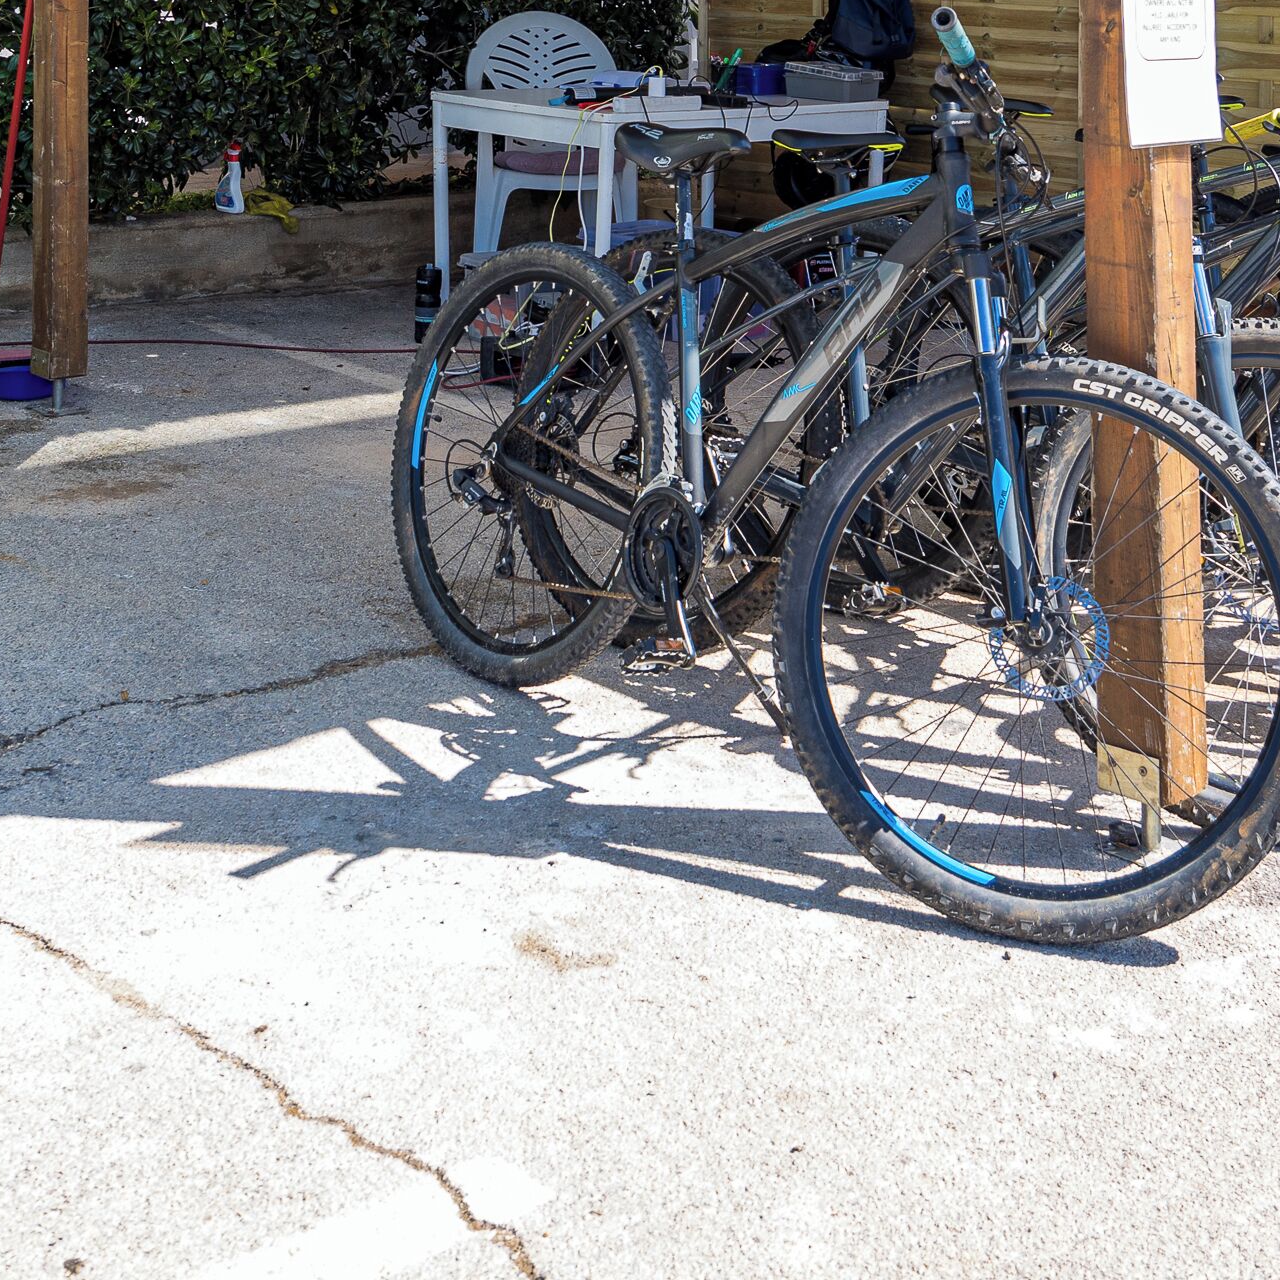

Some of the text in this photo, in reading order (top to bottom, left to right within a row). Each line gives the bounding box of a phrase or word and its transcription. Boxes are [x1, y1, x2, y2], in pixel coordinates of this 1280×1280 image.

[1072, 378, 1247, 483] CST GRIPPER APL
